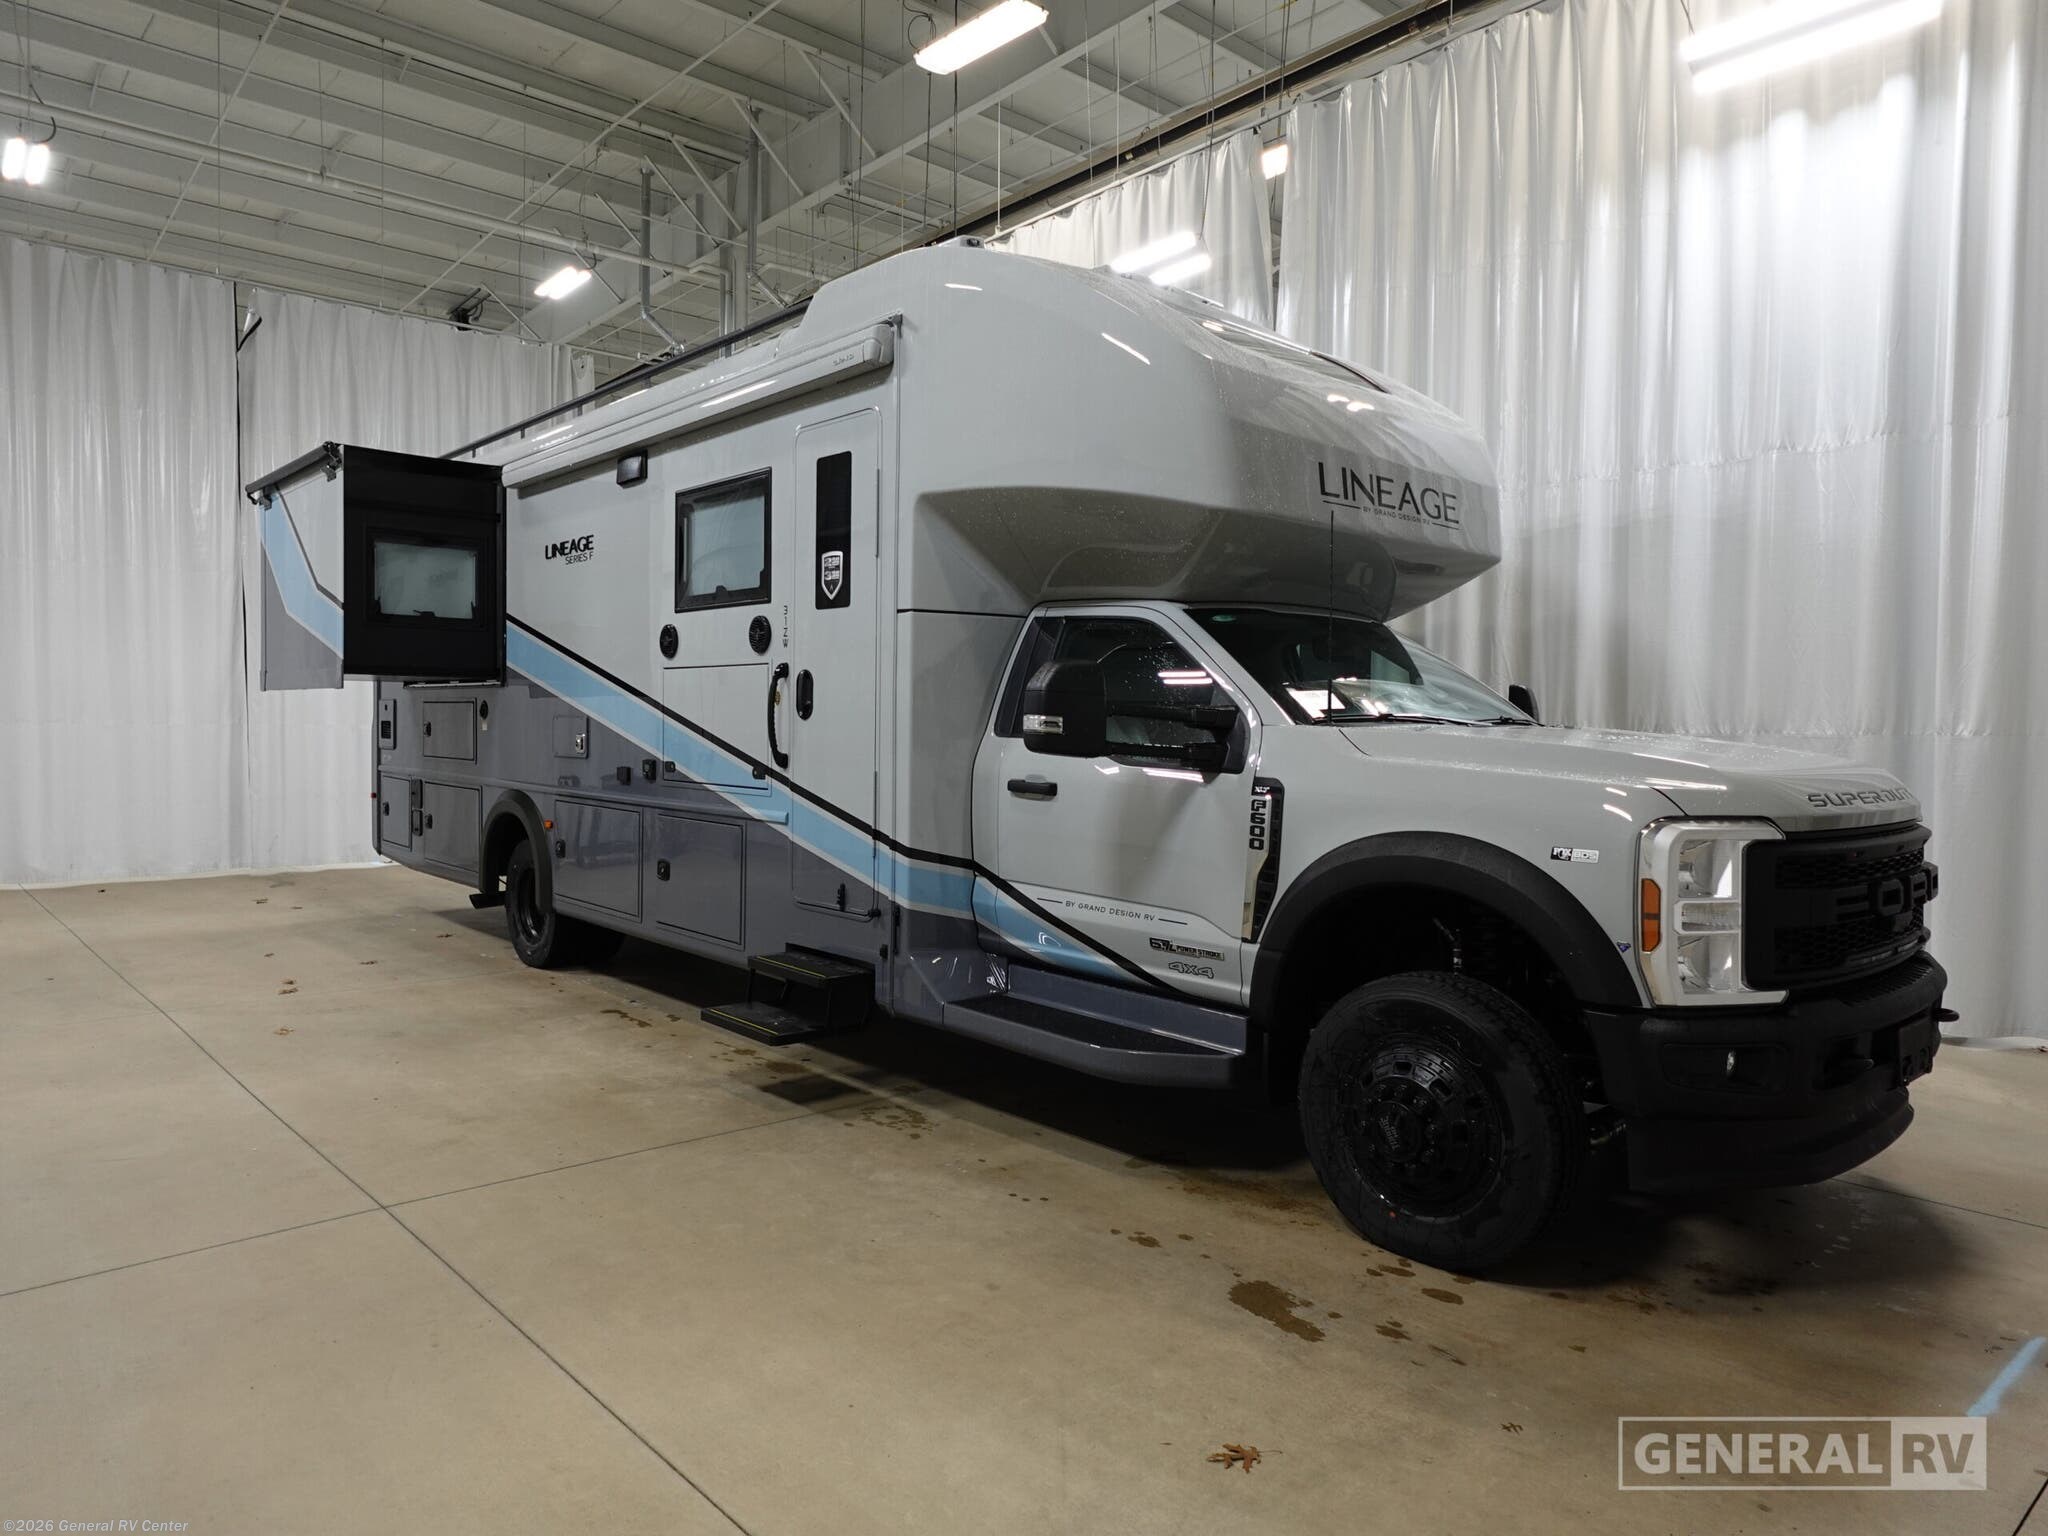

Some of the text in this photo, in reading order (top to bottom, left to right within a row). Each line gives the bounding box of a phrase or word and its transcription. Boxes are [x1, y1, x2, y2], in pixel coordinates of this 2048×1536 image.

[1318, 462, 1459, 524] LINEAGE
[545, 534, 594, 560] LINEAGE
[565, 551, 593, 565] SERIES F
[1249, 799, 1267, 850] F600
[1553, 847, 1572, 857] FOX
[1065, 900, 1155, 921] BY GRAND DESIGN RV
[1168, 961, 1214, 979] 4X4
